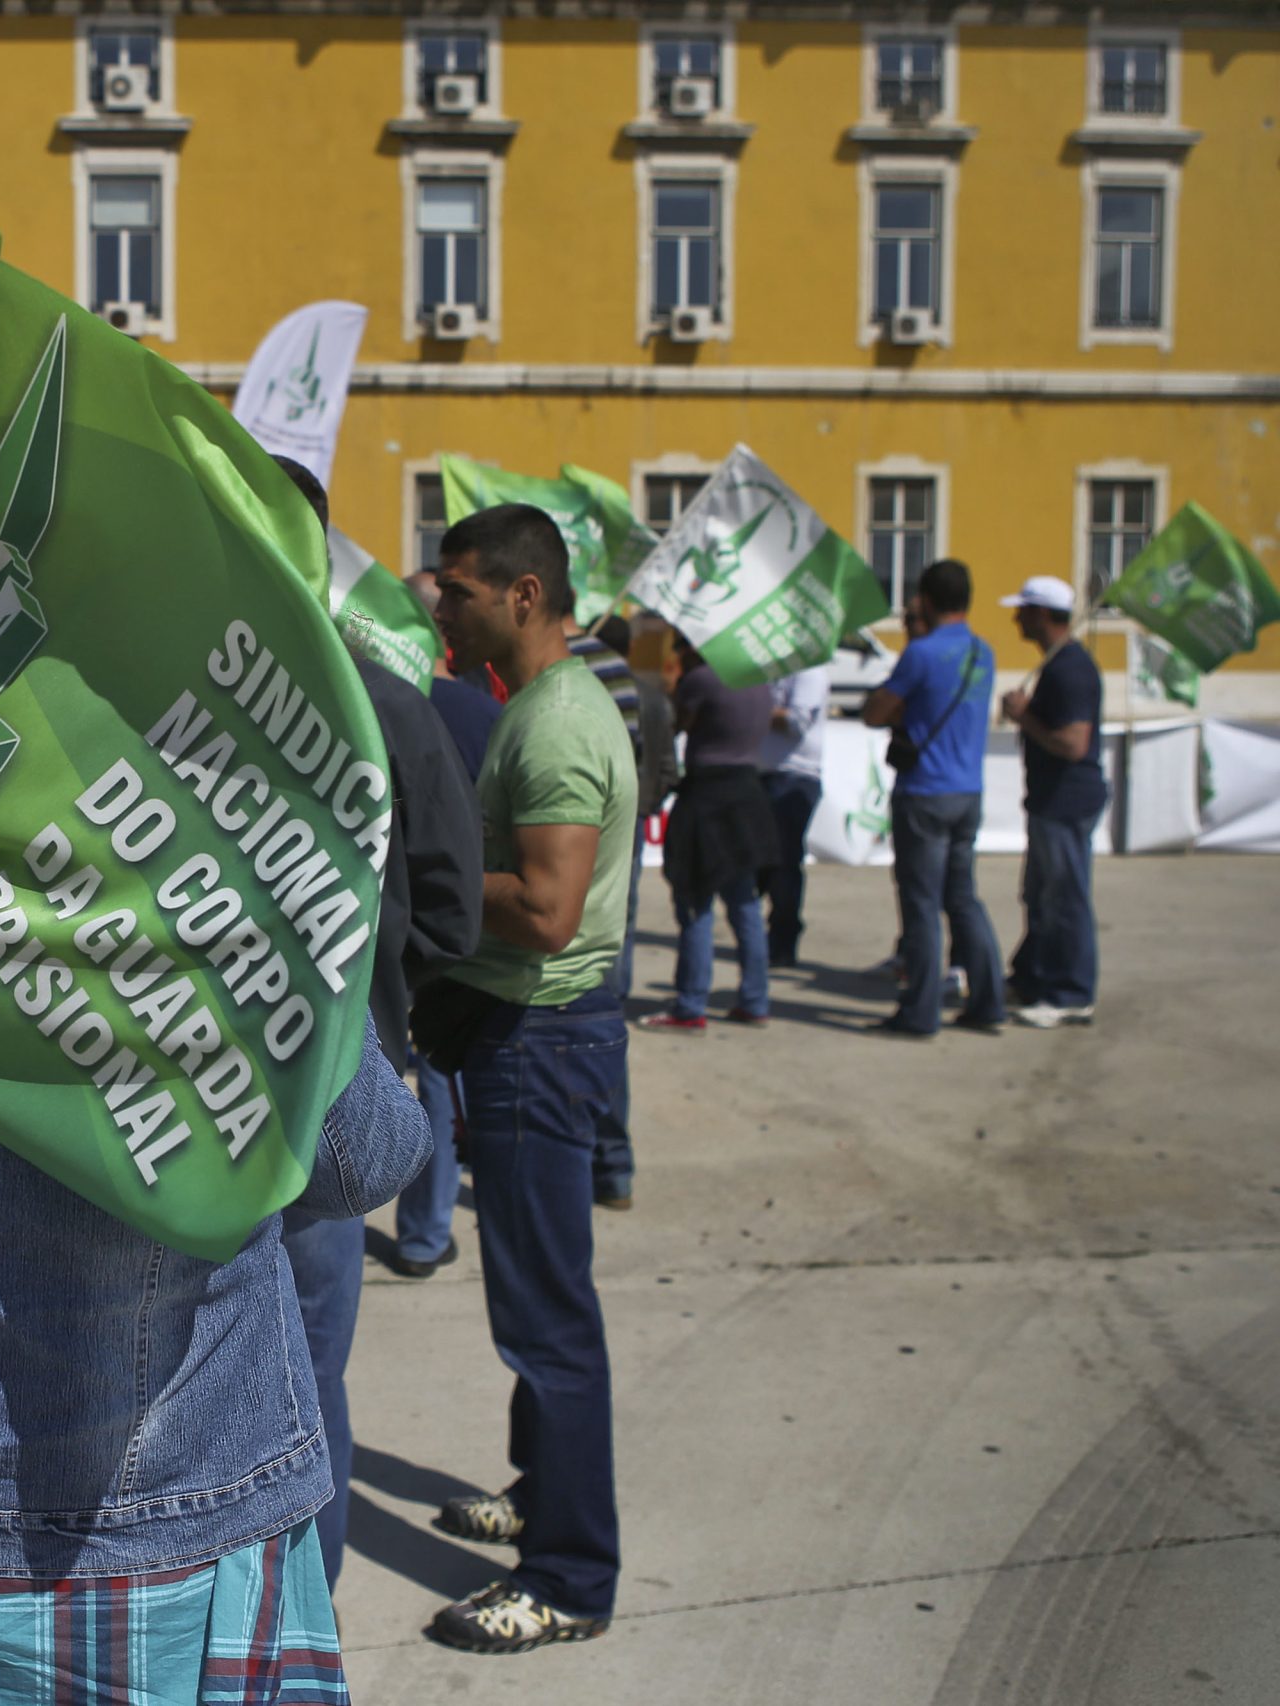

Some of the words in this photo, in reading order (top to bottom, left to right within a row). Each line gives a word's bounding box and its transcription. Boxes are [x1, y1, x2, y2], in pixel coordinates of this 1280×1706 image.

[144, 689, 371, 994] NACIONAL
[207, 619, 393, 893] SINDICA
[23, 822, 104, 921] DA
[73, 908, 272, 1160] GUARDA
[74, 758, 176, 862] DO
[157, 853, 314, 1062] CORPO
